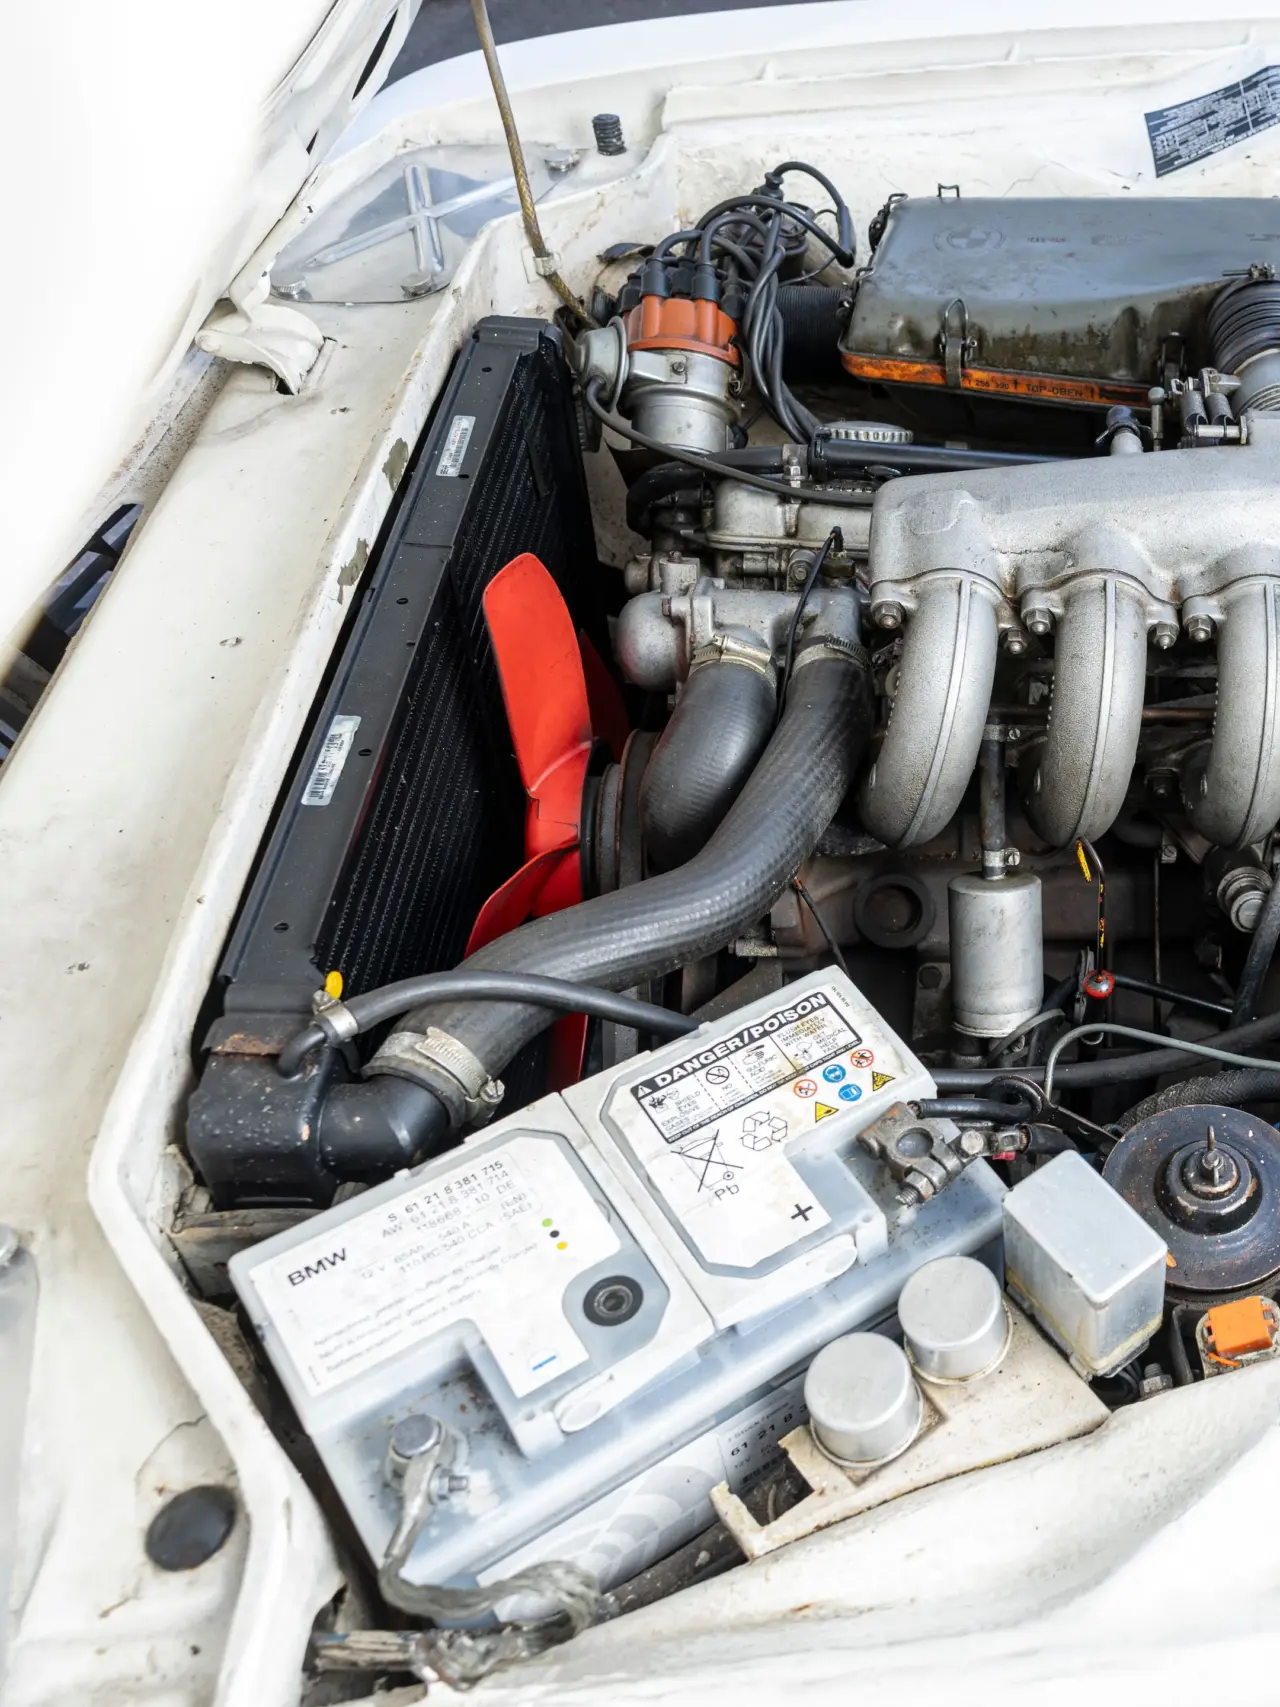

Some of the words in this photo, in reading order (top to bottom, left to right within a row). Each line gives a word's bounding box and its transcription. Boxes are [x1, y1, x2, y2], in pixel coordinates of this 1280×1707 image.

[1025, 383, 1085, 398] TOP-OBEN
[655, 994, 827, 1087] DANGER/POISON
[674, 1091, 700, 1108] SHIELD
[677, 1100, 696, 1112] EYES
[382, 1222, 402, 1237] AW
[409, 1210, 426, 1223] 61
[432, 1200, 445, 1214] 21
[460, 1182, 483, 1198] 381
[487, 1169, 508, 1184] 714
[387, 1213, 397, 1221] S
[404, 1202, 418, 1213] 61
[423, 1192, 439, 1204] 21
[443, 1185, 452, 1194] 8
[454, 1173, 477, 1188] 381
[481, 1160, 502, 1175] 715
[474, 1192, 489, 1204] 10
[495, 1179, 512, 1194] DE
[714, 1177, 739, 1200] Pb
[288, 1248, 345, 1285] BMW
[731, 1441, 748, 1456] 61
[758, 1423, 775, 1440] 21
[784, 1413, 793, 1423] 8
